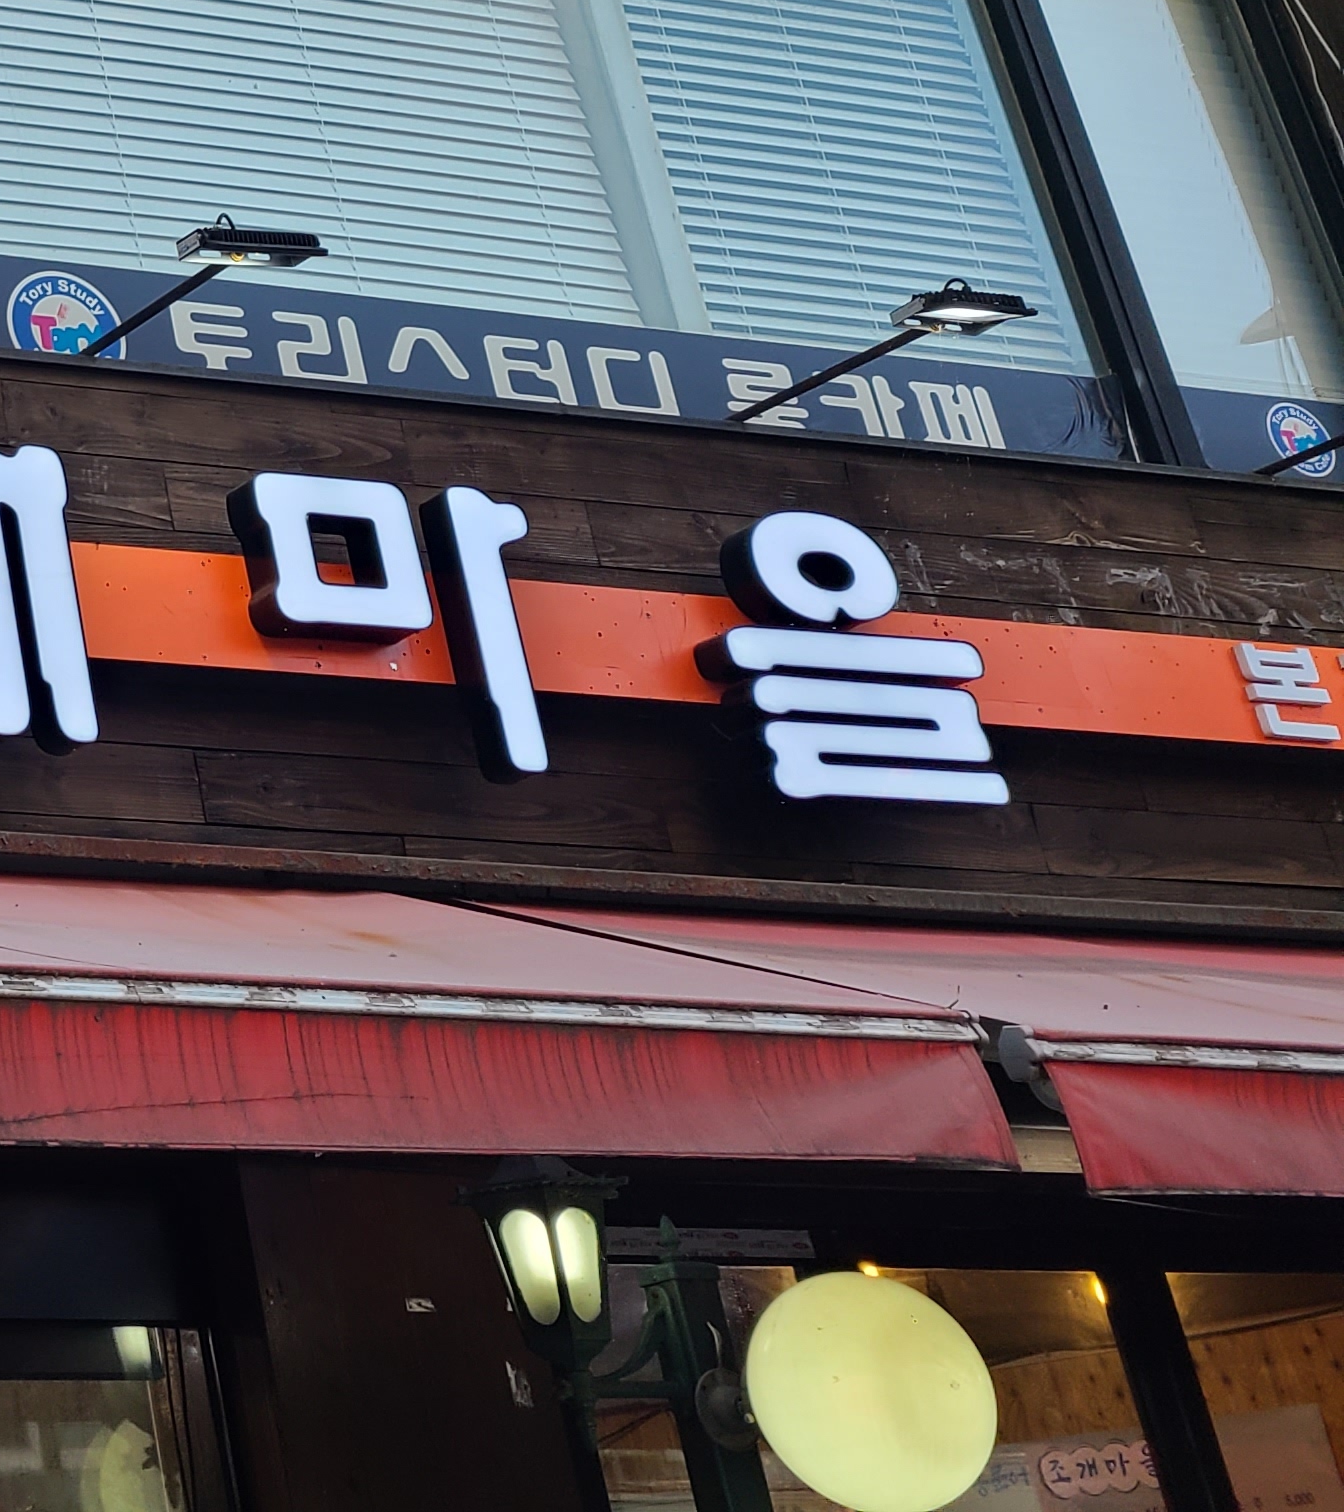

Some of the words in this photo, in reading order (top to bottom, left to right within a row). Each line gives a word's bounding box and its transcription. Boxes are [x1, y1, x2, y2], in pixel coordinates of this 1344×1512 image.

[19, 281, 53, 306] Tory
[57, 279, 105, 316] Study
[1272, 409, 1288, 424] Tory
[1289, 407, 1319, 430] Study
[1232, 642, 1344, 741] 본
